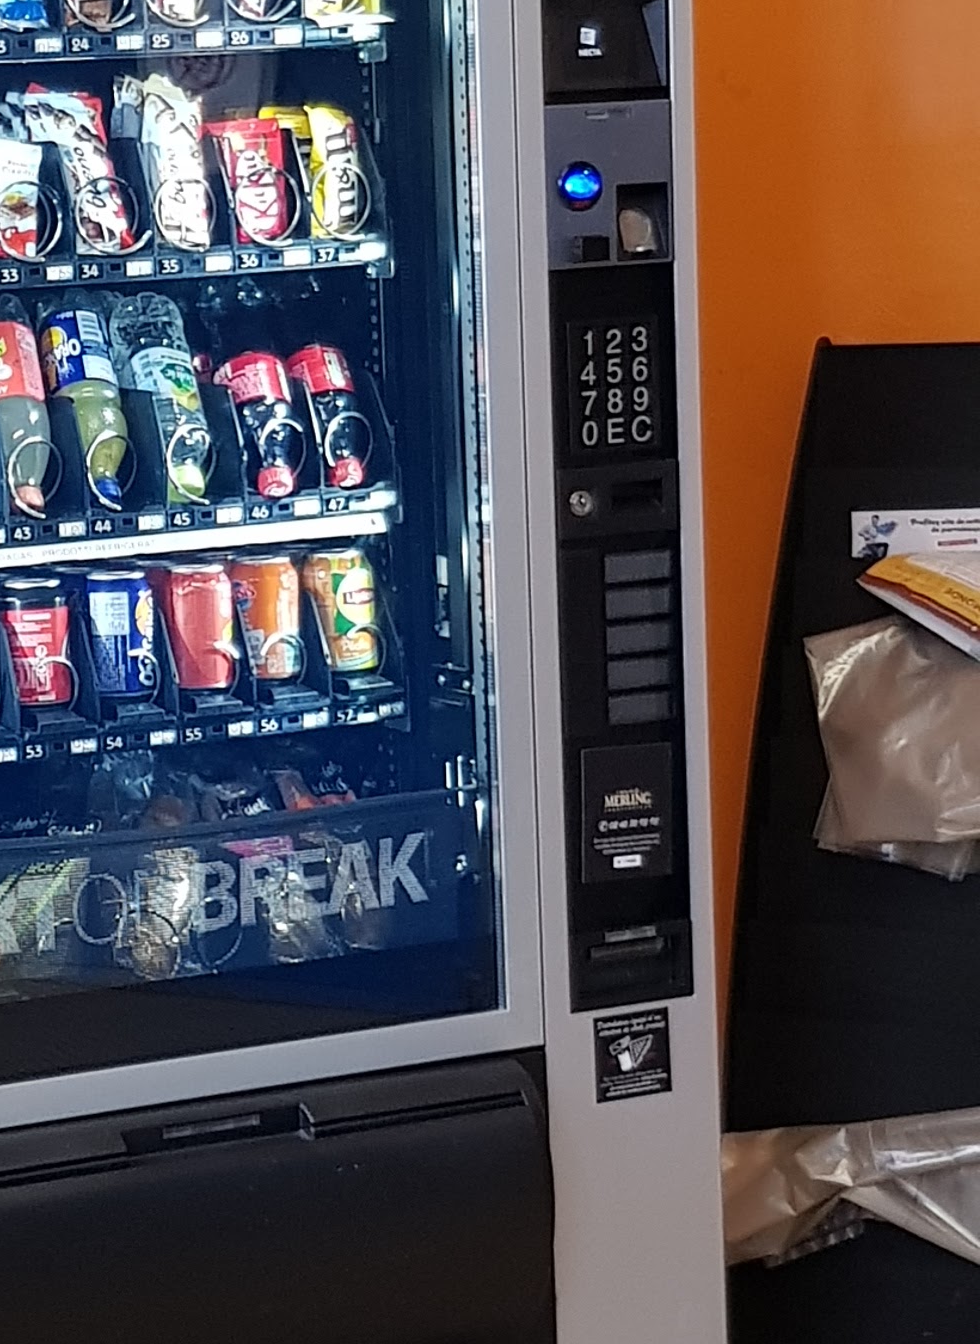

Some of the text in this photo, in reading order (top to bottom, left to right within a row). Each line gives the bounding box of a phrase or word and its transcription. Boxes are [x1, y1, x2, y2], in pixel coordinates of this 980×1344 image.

[71, 36, 90, 52] 24
[151, 34, 170, 49] 25
[230, 31, 249, 45] 26
[239, 253, 258, 268] 36
[316, 248, 335, 263] 37
[81, 263, 99, 279] 34
[161, 258, 180, 273] 35
[0, 268, 19, 283] 33
[582, 326, 648, 355] 1 2 3
[580, 356, 648, 386] 4 5 6
[580, 386, 649, 416] 7 8 9
[581, 415, 653, 446] 0 E C
[327, 497, 346, 512] 47
[173, 512, 191, 526] 45
[251, 506, 270, 520] 46
[13, 526, 32, 541] 43
[94, 518, 113, 534] 44
[336, 709, 354, 724] 57
[260, 717, 279, 733] 56
[105, 735, 123, 750] 54
[185, 728, 203, 742] 55
[25, 745, 44, 759] 53
[191, 832, 430, 935] BREAK
